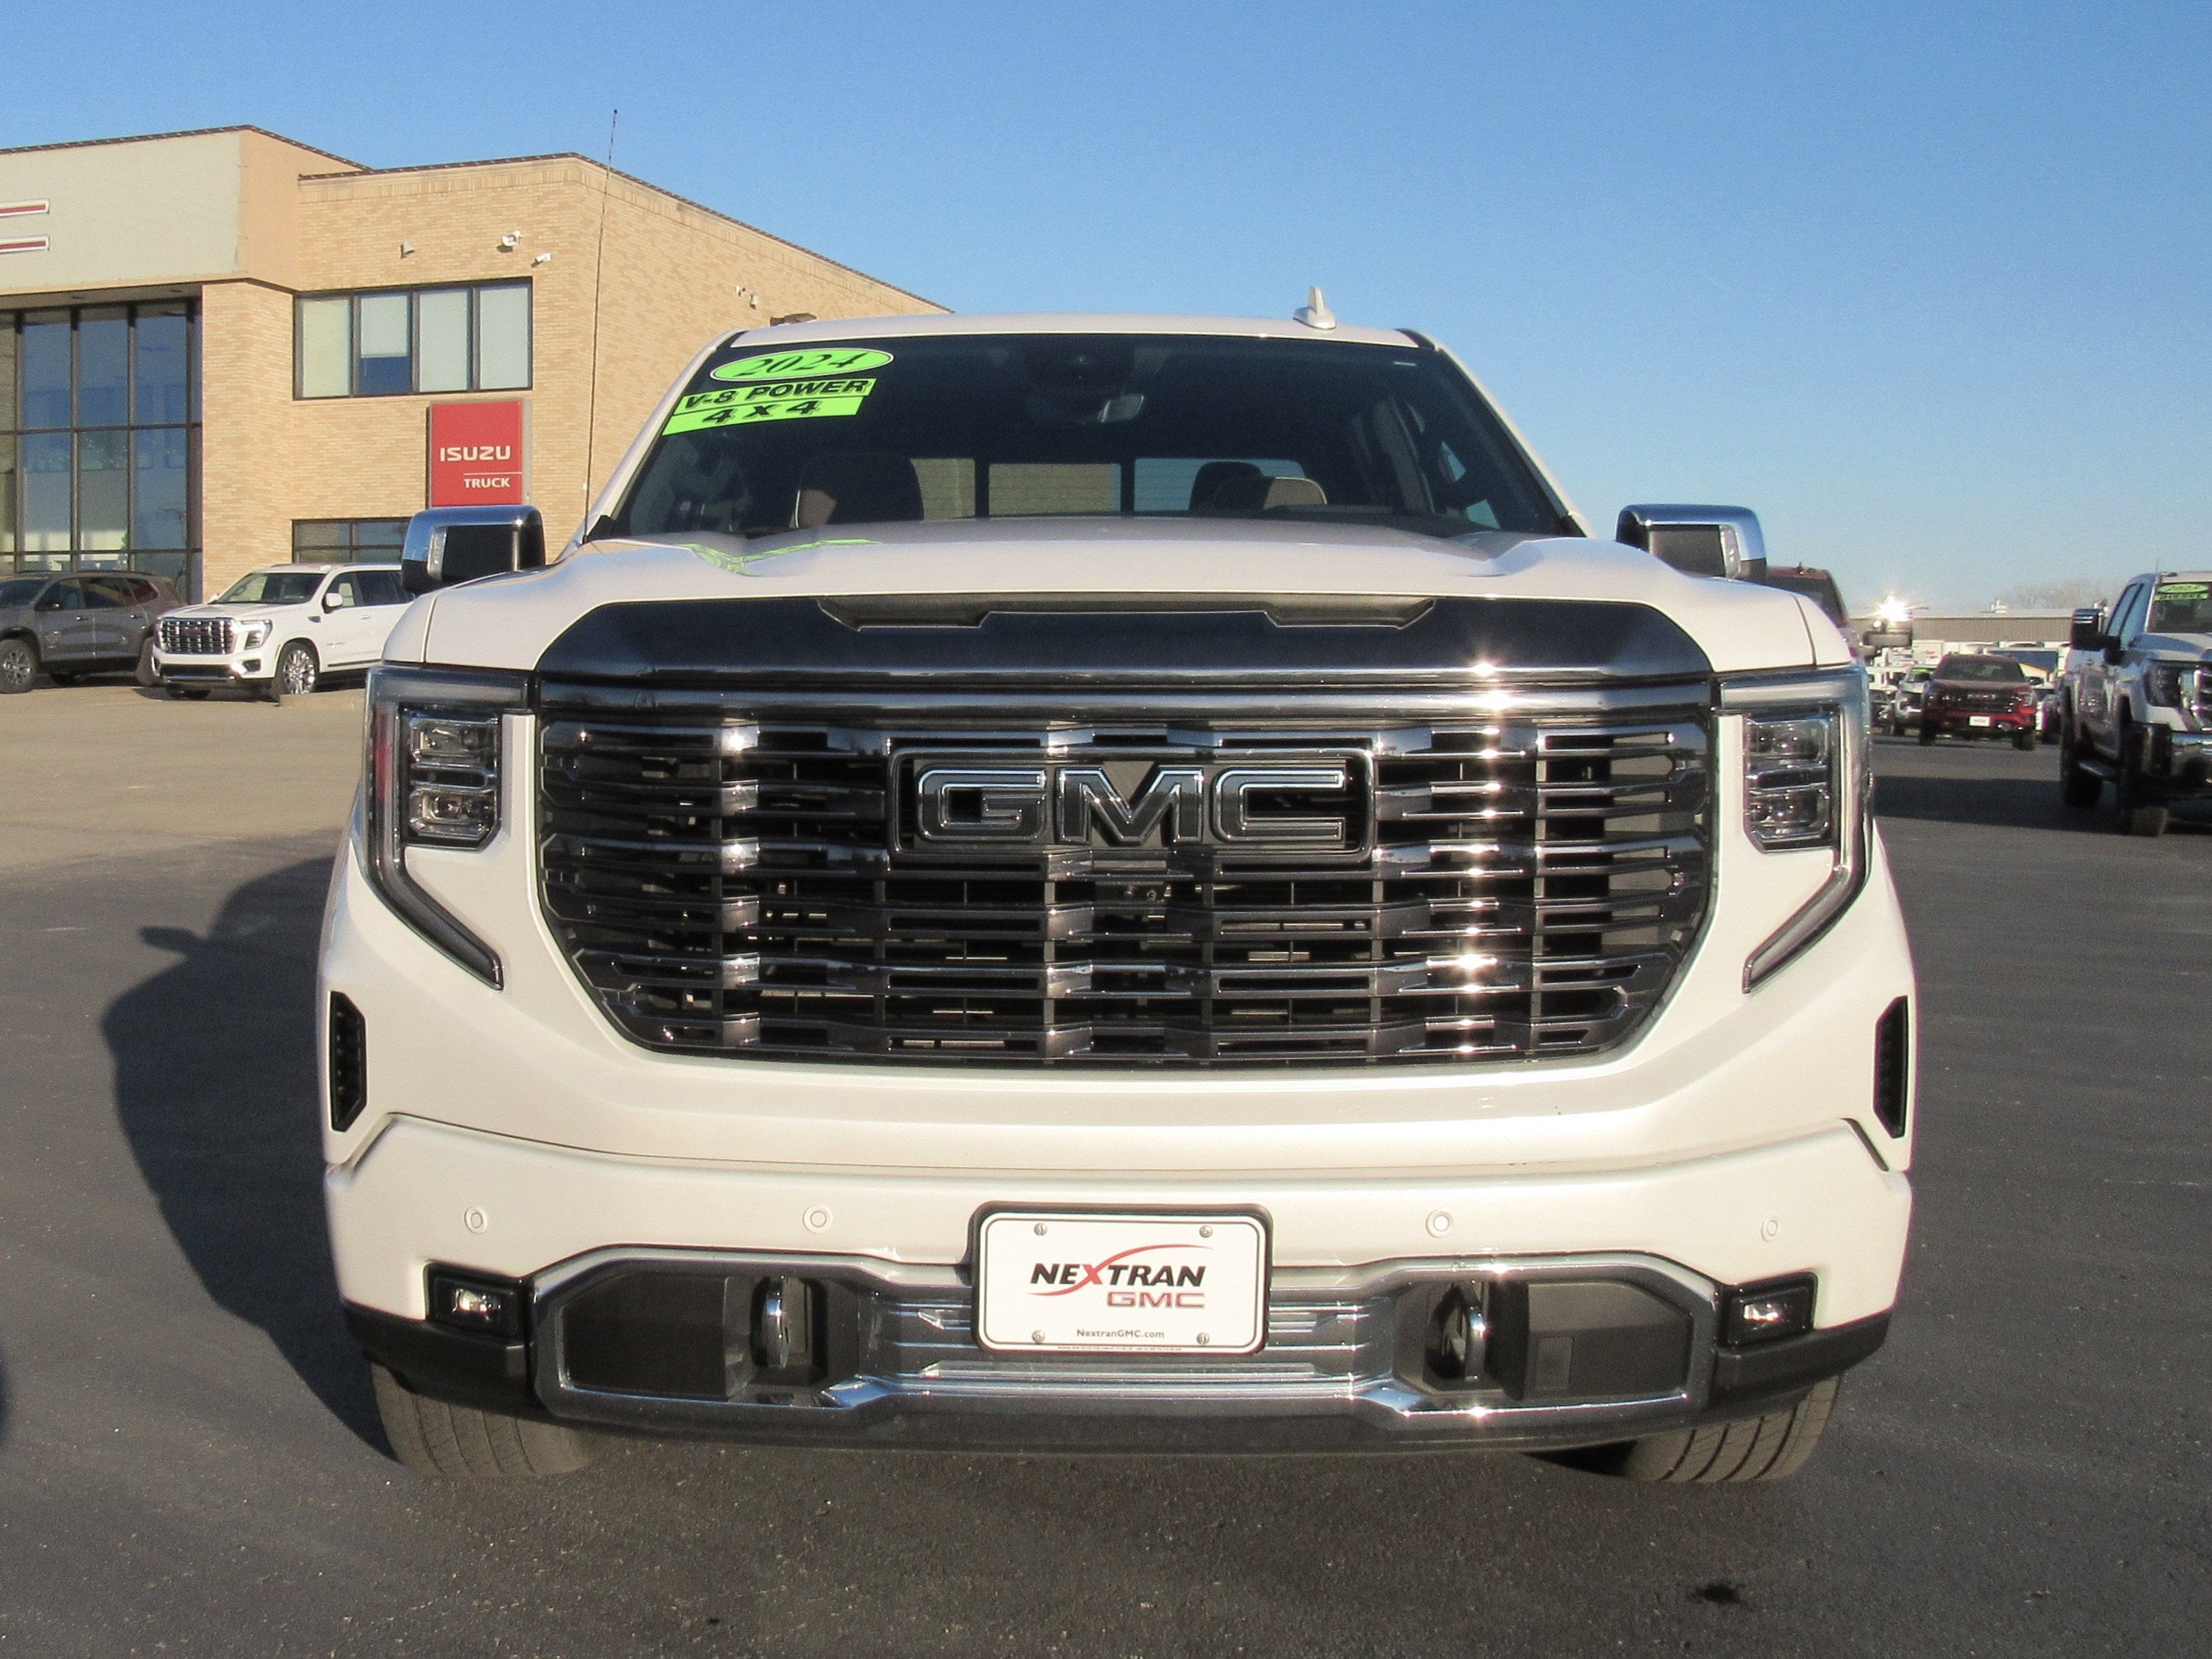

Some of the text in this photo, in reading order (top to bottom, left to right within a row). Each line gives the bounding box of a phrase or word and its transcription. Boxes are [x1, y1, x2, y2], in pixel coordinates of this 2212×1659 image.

[733, 352, 867, 377] 2024
[685, 379, 872, 410] V-8 POWER
[702, 409, 736, 425] 4
[786, 400, 821, 416] 4
[440, 445, 511, 462] ISUZU
[463, 477, 511, 488] TRUCK
[917, 767, 1347, 843] GMC
[1030, 1263, 1206, 1287] NEXTRAN
[1106, 1291, 1206, 1309] GMC
[1076, 1328, 1165, 1339] NextranGMC.com
